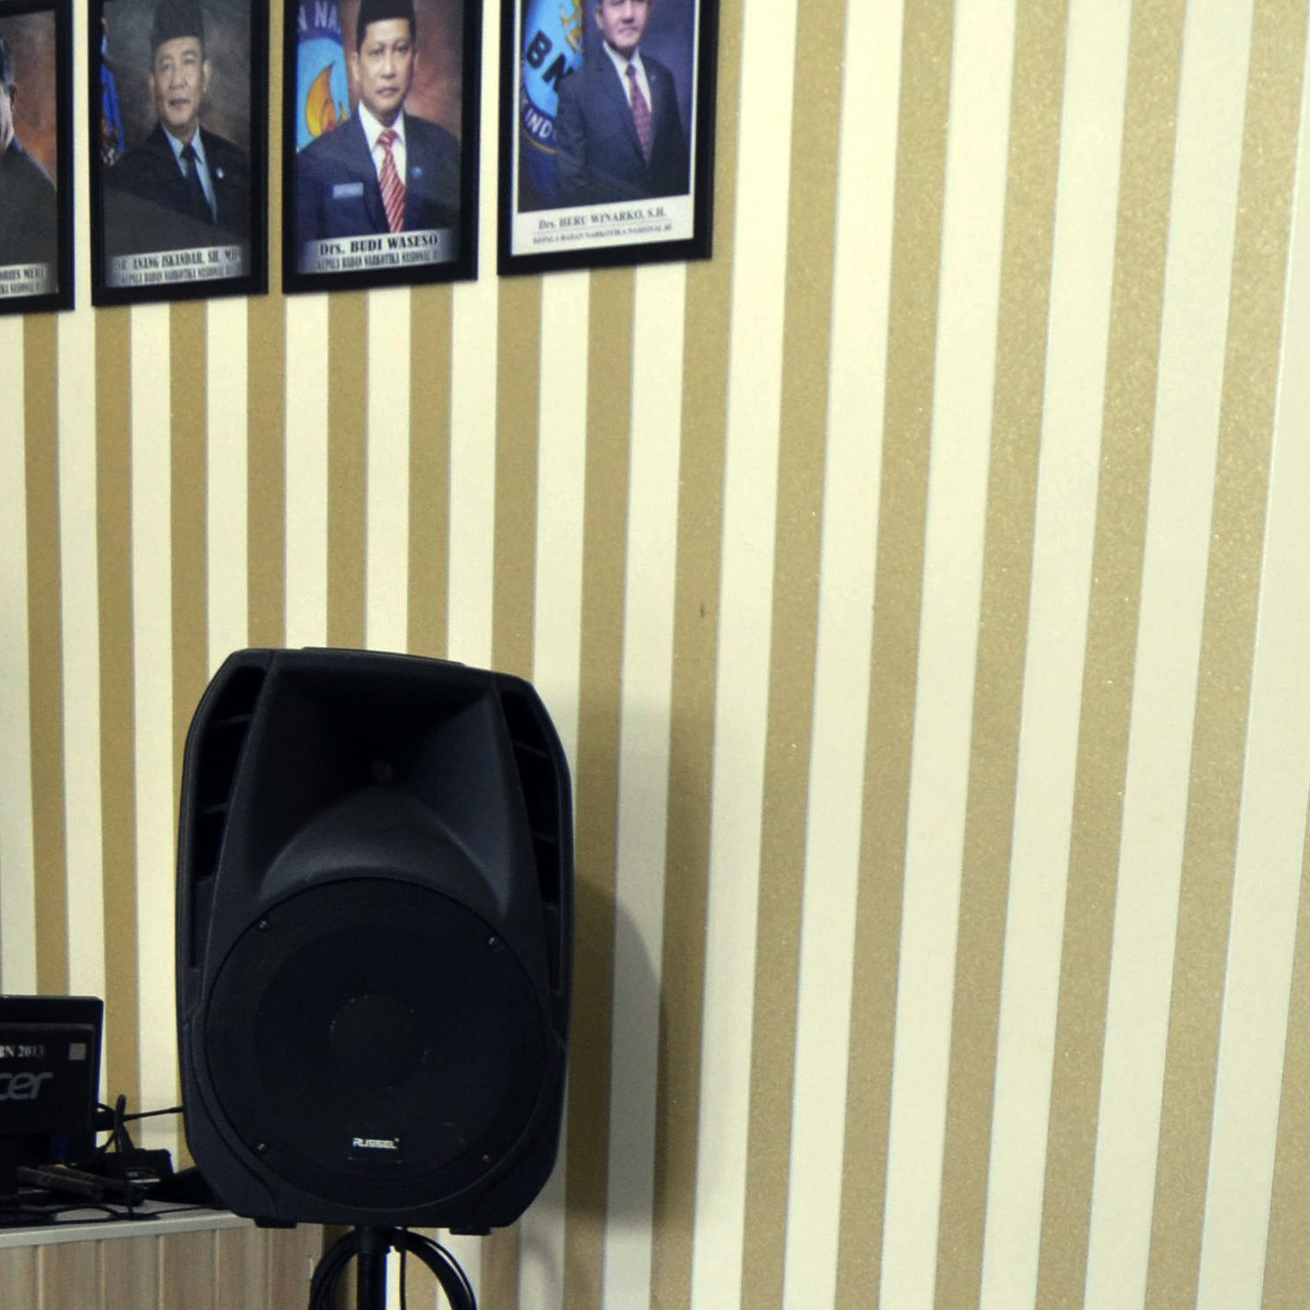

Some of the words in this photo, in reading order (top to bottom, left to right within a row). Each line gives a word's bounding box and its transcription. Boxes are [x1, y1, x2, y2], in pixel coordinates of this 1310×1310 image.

[526, 29, 574, 93] BN
[350, 238, 382, 253] BUDI
[387, 234, 438, 250] WASESO
